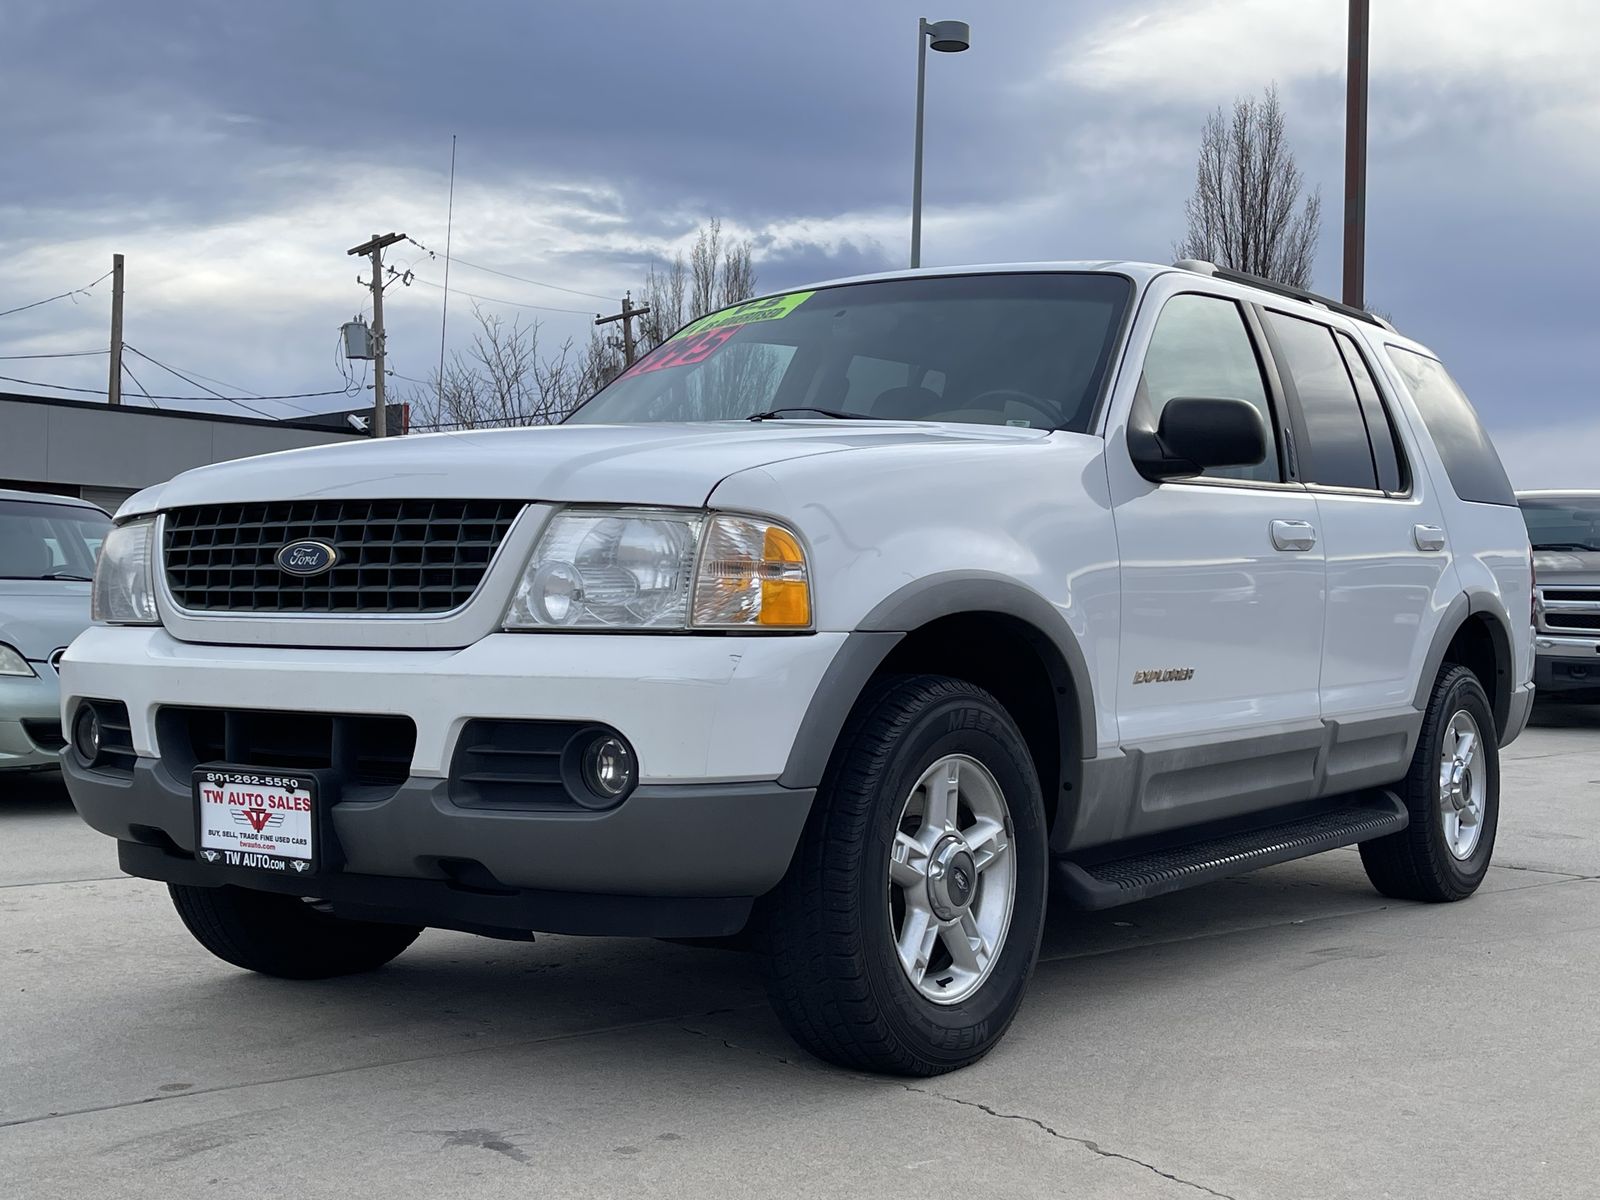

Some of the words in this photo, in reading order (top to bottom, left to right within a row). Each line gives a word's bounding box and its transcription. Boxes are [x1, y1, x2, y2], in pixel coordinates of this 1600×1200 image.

[290, 547, 320, 565] Ford
[1133, 667, 1195, 685] EXPLORER
[207, 773, 298, 788] 801-262-5550
[203, 790, 223, 804] TW
[228, 792, 264, 807] AUTO
[268, 795, 311, 812] SALES
[208, 829, 221, 837] BUY,
[222, 831, 238, 839] SELL,
[260, 834, 273, 842] FINE
[274, 836, 290, 844] USED
[239, 841, 276, 850] twauto.com
[224, 851, 241, 865] TW
